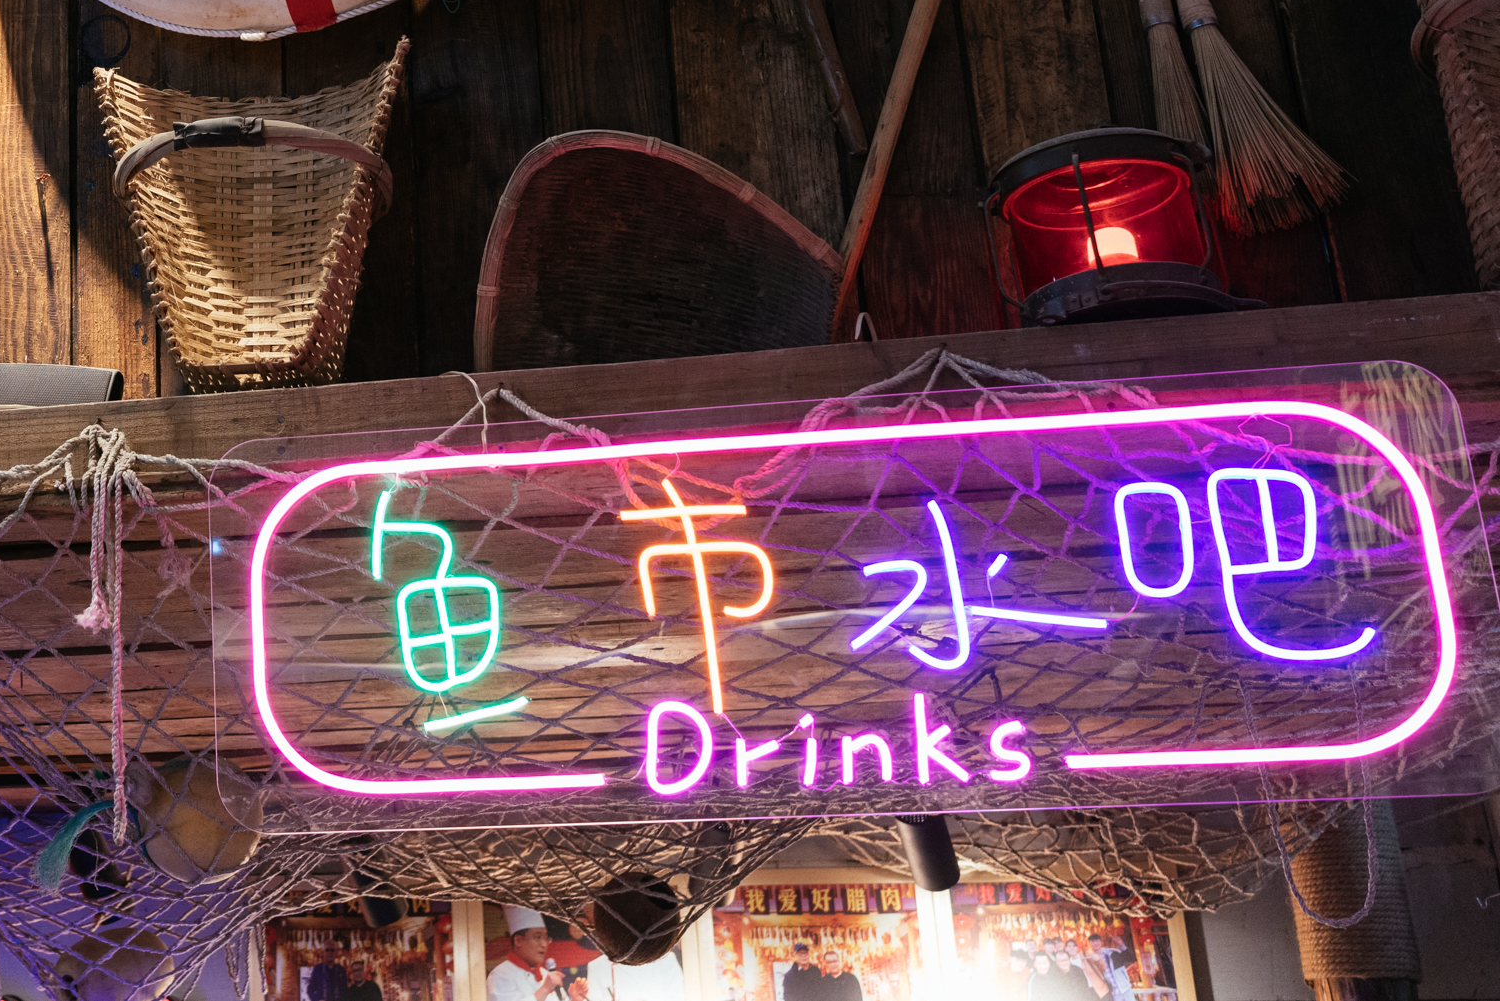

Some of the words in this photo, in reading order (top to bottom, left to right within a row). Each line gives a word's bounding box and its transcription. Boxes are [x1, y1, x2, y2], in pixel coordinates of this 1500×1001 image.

[372, 468, 1377, 732] 鱼市水吧
[645, 692, 1034, 796] Drinks
[745, 887, 902, 912] 我爱好腊肉
